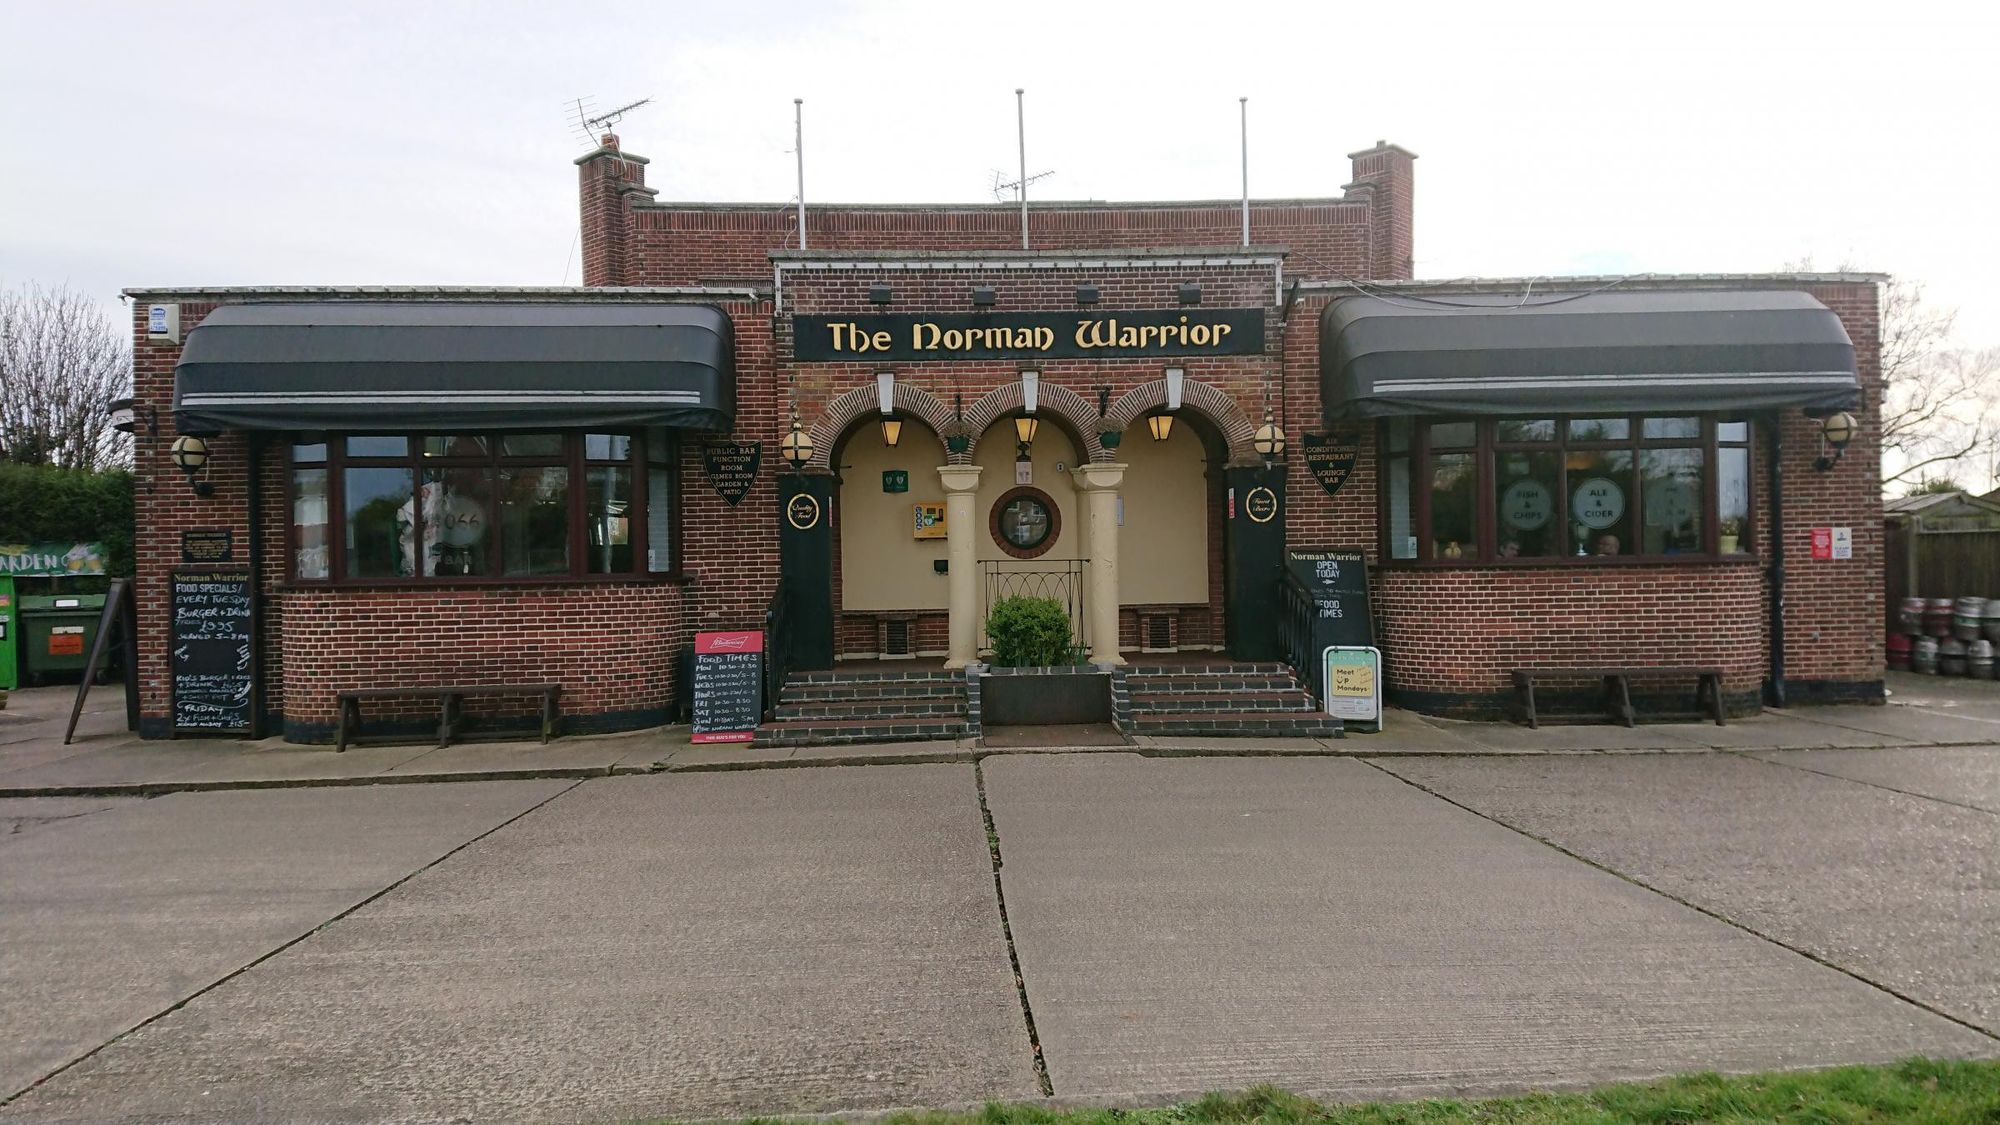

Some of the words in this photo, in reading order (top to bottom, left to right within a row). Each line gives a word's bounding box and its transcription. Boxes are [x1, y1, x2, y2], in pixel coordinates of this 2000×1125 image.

[826, 322, 892, 353] The
[912, 322, 1054, 350] Norman
[1074, 315, 1232, 348] Warrior
[706, 447, 736, 455] PUBLIC
[739, 447, 756, 455] BAR
[1308, 453, 1354, 461] RESTAURANT
[1589, 489, 1607, 497] ALE
[1584, 510, 1613, 518] CIDER
[1291, 552, 1325, 561] Norman
[1327, 552, 1361, 561] Warrior
[1317, 561, 1338, 570] OPEN
[174, 574, 210, 582] Norman
[212, 573, 249, 582] Warrior
[1315, 569, 1341, 579] TODAY
[176, 583, 198, 593] FOOD
[176, 595, 208, 605] EVERY
[212, 595, 250, 608] TUESDAY
[1319, 600, 1340, 609] FOOD
[177, 607, 218, 619] BURGER
[1319, 609, 1343, 618] TIMES
[697, 655, 723, 664] FOOD
[723, 654, 757, 662] TIMES
[1337, 685, 1368, 693] Mondays
[184, 704, 223, 714] FRIDAY
[693, 709, 710, 717] SAT
